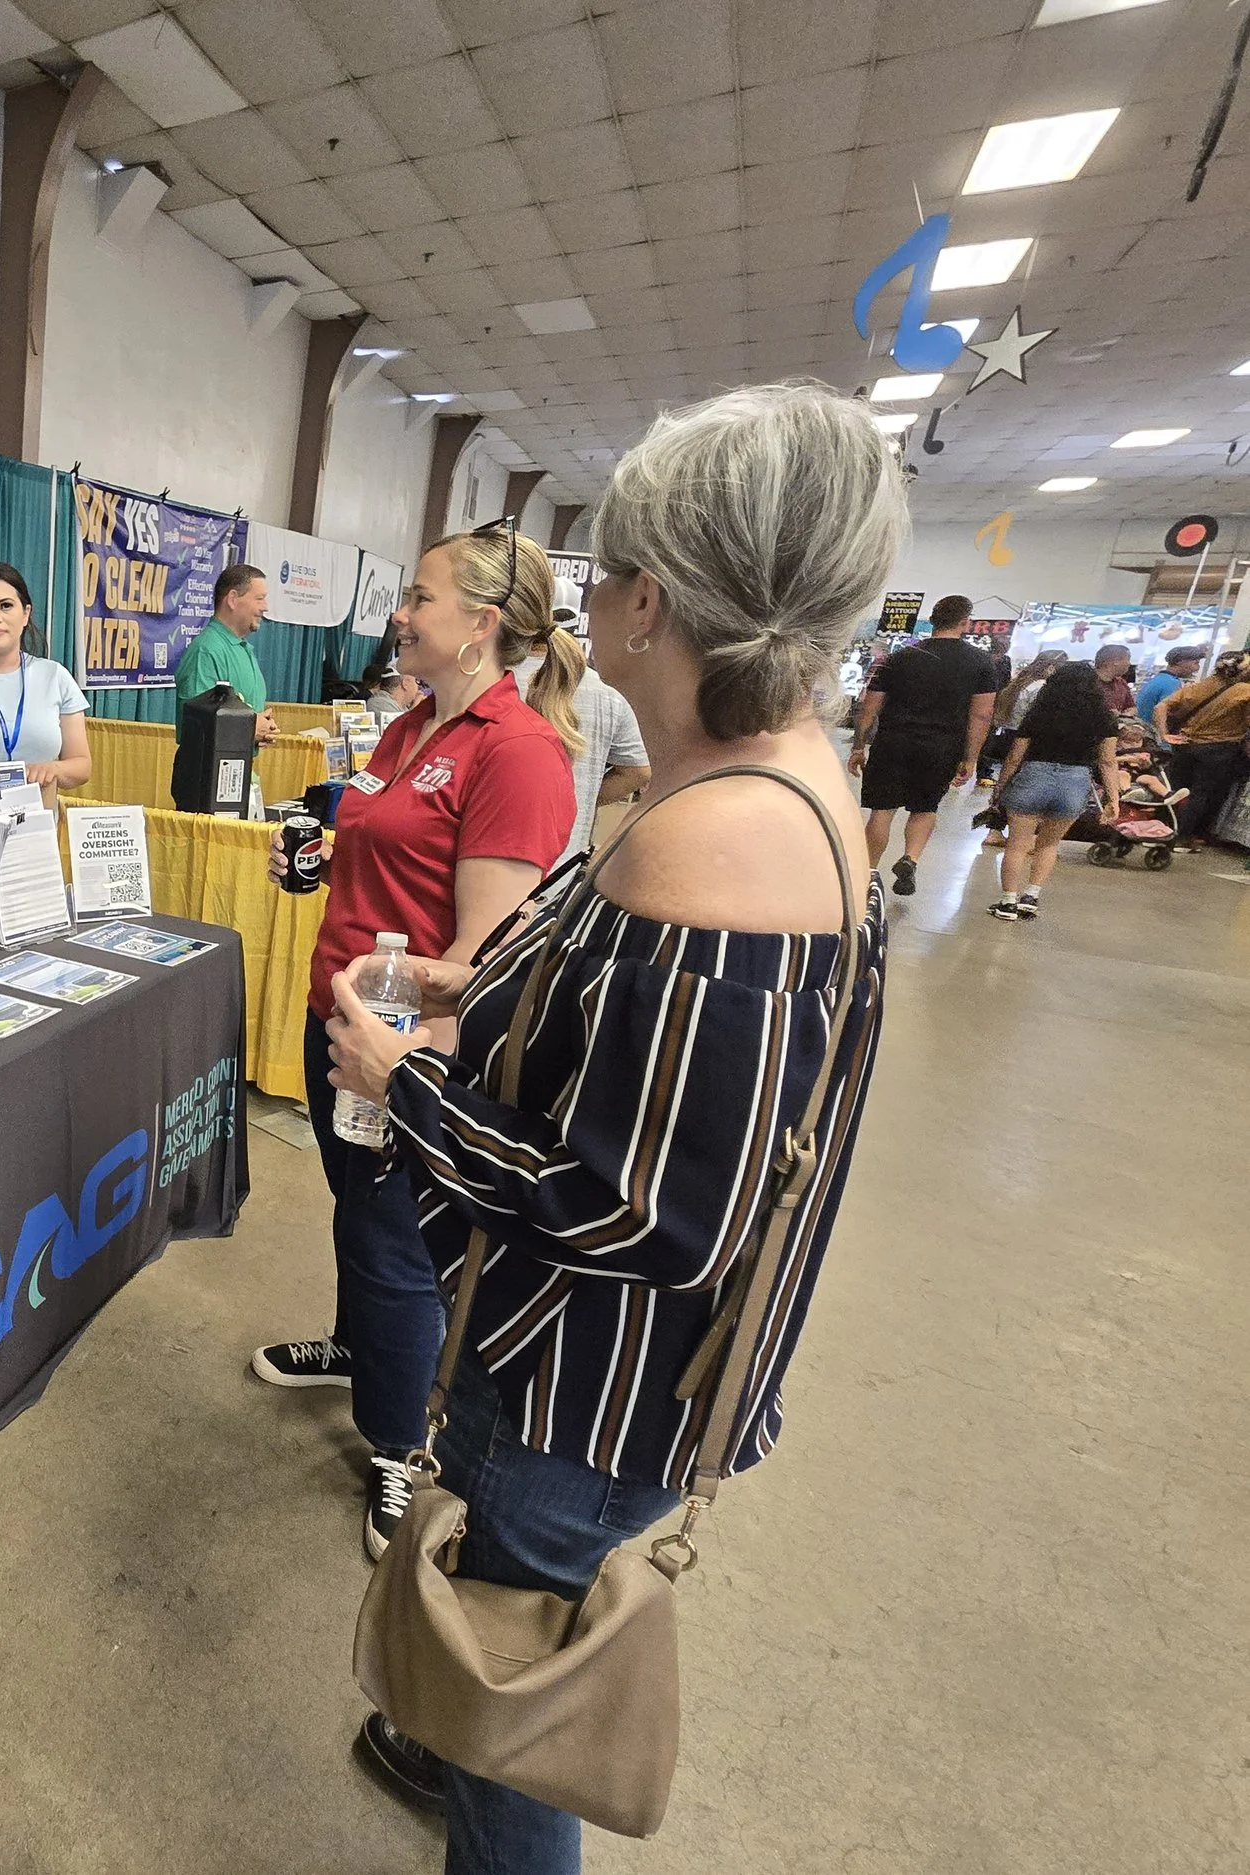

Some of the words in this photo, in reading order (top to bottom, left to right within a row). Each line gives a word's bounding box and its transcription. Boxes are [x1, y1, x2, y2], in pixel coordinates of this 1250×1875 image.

[76, 483, 121, 546] SAY
[123, 498, 160, 555] YES
[105, 556, 169, 613] CLEAN
[86, 829, 129, 839] CITIZENS
[81, 839, 134, 849] OVERSIGHT
[78, 848, 139, 859] COMMITTEE?
